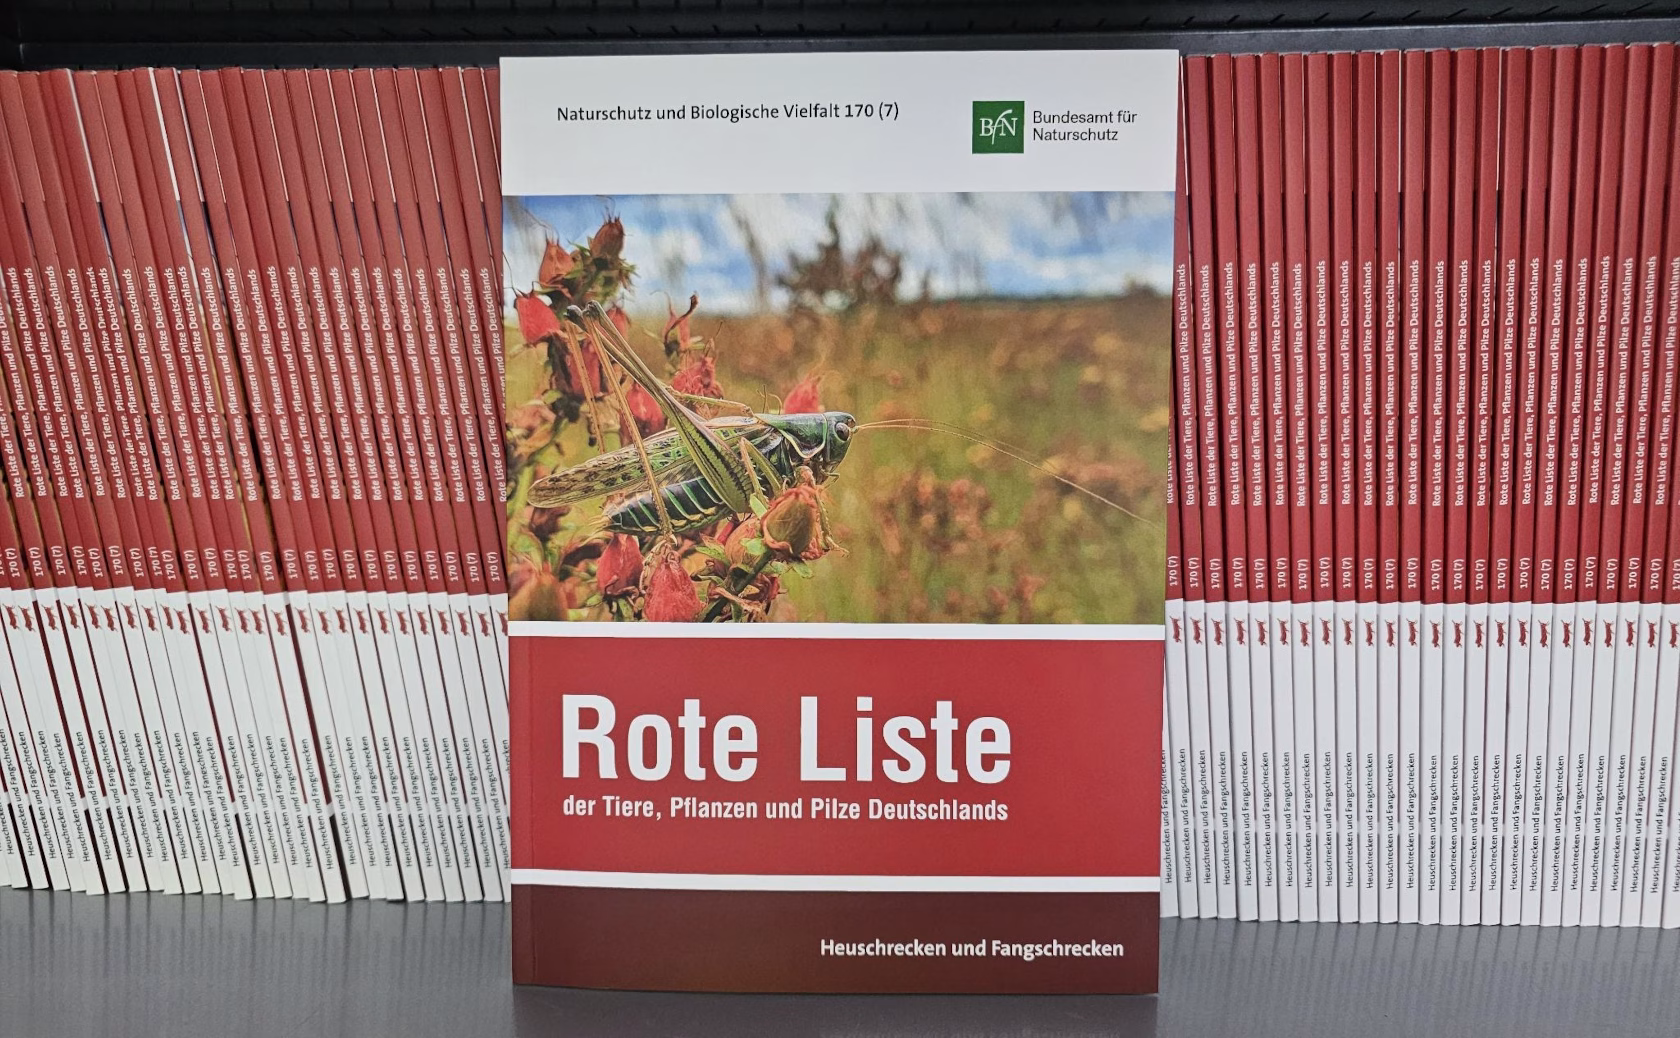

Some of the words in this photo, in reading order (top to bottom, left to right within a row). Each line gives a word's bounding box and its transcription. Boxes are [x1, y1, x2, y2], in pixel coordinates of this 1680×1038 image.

[558, 106, 651, 120] Naturschutz
[657, 105, 685, 119] und
[692, 104, 778, 123] Biologische
[784, 104, 839, 117] Vielfalt
[846, 104, 873, 117] 170
[879, 102, 898, 120] (7)
[1034, 111, 1113, 123] Bundesamt
[1117, 111, 1137, 122] für
[980, 109, 1018, 144] BfN
[1034, 128, 1118, 140] Naturschutz
[6, 267, 28, 329] Deutschlands
[66, 268, 88, 330] Deutschlands
[164, 267, 184, 330] Deutschlands
[267, 265, 286, 328] Deutschlands
[350, 267, 370, 330] Deutschlands
[1176, 263, 1188, 328] Deutschlands
[1270, 261, 1280, 327] Deutschlands
[1362, 261, 1371, 327] Deutschlands
[1505, 258, 1515, 325] Deutschlands
[1620, 257, 1632, 324] Deutschlands
[23, 330, 34, 351] Pilze
[82, 331, 93, 352] Pilze
[178, 331, 189, 353] Pilze
[280, 330, 290, 351] Pilze
[364, 332, 374, 353] Pilze
[1179, 330, 1188, 353] Pilze
[1271, 329, 1280, 351] Pilze
[1363, 329, 1372, 351] Pilze
[1504, 327, 1513, 349] Pilze
[1619, 326, 1629, 348] Pilze
[26, 353, 38, 371] und
[85, 354, 97, 372] und
[181, 354, 193, 372] und
[283, 353, 295, 371] und
[367, 355, 378, 373] und
[1180, 354, 1189, 373] und
[1272, 353, 1281, 372] und
[1363, 353, 1372, 372] und
[1503, 351, 1512, 370] und
[1618, 351, 1627, 370] und
[33, 372, 48, 411] Pflanzen
[92, 374, 106, 412] Pflanzen
[188, 374, 202, 413] Pflanzen
[289, 373, 303, 412] Pflanzen
[372, 375, 386, 414] Pflanzen
[1182, 375, 1191, 415] Pflanzen
[1272, 374, 1282, 415] Pflanzen
[1362, 374, 1372, 415] Pflanzen
[1502, 372, 1511, 414] Pflanzen
[1615, 372, 1626, 413] Pflanzen
[43, 412, 54, 437] Tiere,
[102, 413, 112, 439] Tiere,
[197, 414, 207, 440] Tiere,
[298, 413, 308, 438] Tiere,
[380, 415, 390, 440] Tiere,
[1183, 417, 1192, 443] Tiere,
[1274, 416, 1283, 442] Tiere,
[1363, 416, 1372, 443] Tiere,
[1501, 415, 1511, 442] Tiere,
[1614, 415, 1625, 441] Tiere,
[48, 438, 58, 453] der
[106, 440, 116, 455] der
[202, 441, 211, 456] der
[302, 440, 311, 455] der
[385, 441, 394, 456] der
[1184, 444, 1192, 460] der
[1274, 444, 1283, 459] der
[1363, 444, 1372, 460] der
[1500, 443, 1509, 459] der
[1612, 443, 1622, 458] der
[52, 454, 63, 475] Liste
[110, 456, 121, 476] Liste
[205, 457, 216, 478] Liste
[305, 456, 316, 477] Liste
[388, 458, 398, 479] Liste
[1185, 461, 1194, 482] Liste
[1275, 461, 1283, 482] Liste
[1363, 461, 1372, 483] Liste
[1500, 460, 1509, 482] Liste
[1612, 460, 1621, 482] Liste
[57, 476, 68, 496] Rote
[115, 478, 126, 498] Rote
[210, 479, 220, 499] Rote
[310, 478, 320, 498] Rote
[392, 480, 402, 500] Rote
[1186, 484, 1194, 505] Rote
[1275, 484, 1284, 505] Rote
[1364, 484, 1372, 505] Rote
[1499, 483, 1508, 505] Rote
[1610, 483, 1620, 505] Rote
[72, 545, 84, 557] (7)
[129, 547, 141, 559] (7)
[223, 549, 235, 561] (7)
[322, 548, 334, 560] (7)
[404, 550, 416, 562] (7)
[76, 558, 87, 575] 170
[133, 560, 144, 577] 170
[226, 562, 237, 578] 170
[325, 562, 336, 578] 170
[407, 564, 418, 580] 170
[1188, 557, 1199, 569] (7)
[1276, 557, 1287, 569] (7)
[1363, 558, 1374, 570] (7)
[1496, 558, 1507, 570] (7)
[1606, 558, 1617, 571] (7)
[1189, 570, 1198, 587] 170
[1277, 571, 1286, 588] 170
[1364, 572, 1372, 588] 170
[1497, 572, 1505, 589] 170
[1606, 572, 1615, 589] 170
[563, 694, 757, 782] Rote
[801, 696, 1010, 784] Liste
[118, 729, 136, 786] Fangschrecken
[174, 732, 191, 789] Fangschrecken
[265, 735, 282, 793] Fangschrecken
[362, 736, 377, 793] Fangschrecken
[442, 737, 457, 795] Fangschrecken
[1198, 749, 1209, 809] Fangschrecken
[1282, 751, 1292, 811] Fangschrecken
[1365, 753, 1375, 813] Fangschrecken
[1490, 754, 1501, 814] Fangschrecken
[1594, 755, 1604, 815] Fangschrecken
[130, 788, 140, 803] und
[185, 791, 195, 806] und
[276, 794, 286, 810] und
[371, 795, 381, 811] und
[451, 797, 461, 812] und
[563, 795, 596, 815] der
[602, 796, 661, 820] Tiere,
[671, 797, 757, 818] Pflanzen
[766, 798, 802, 818] und
[811, 798, 860, 819] Pilze
[869, 799, 1008, 820] Deutschlands
[1200, 811, 1208, 826] und
[1490, 816, 1498, 832] und
[136, 805, 153, 858] Heuschrecken
[191, 808, 208, 861] Heuschrecken
[282, 811, 298, 865] Heuschrecken
[377, 812, 391, 866] Heuschrecken
[456, 814, 471, 868] Heuschrecken
[1201, 828, 1211, 883] Heuschrecken
[1284, 831, 1292, 886] Heuschrecken
[1365, 832, 1373, 888] Heuschrecken
[1489, 834, 1497, 890] Heuschrecken
[1590, 835, 1600, 891] Heuschrecken
[821, 939, 946, 956] Heuschrecken
[952, 939, 986, 956] und
[992, 939, 1123, 961] Fangschrecken
